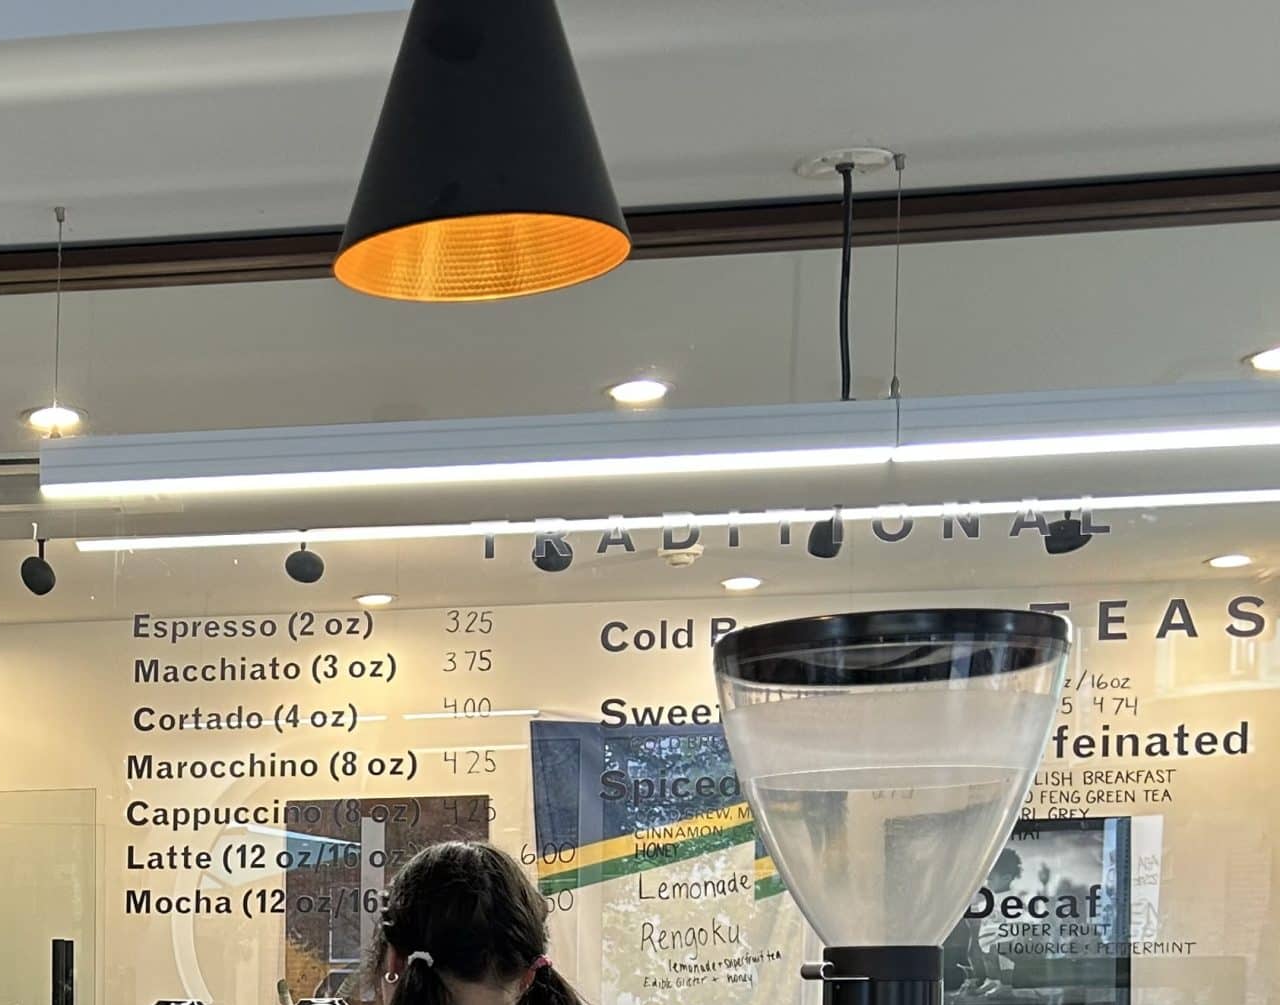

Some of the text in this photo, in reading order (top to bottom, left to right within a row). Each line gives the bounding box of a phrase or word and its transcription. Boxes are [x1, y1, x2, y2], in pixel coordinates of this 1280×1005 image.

[470, 500, 1112, 559] TRADITIONAL
[133, 610, 374, 643] Espresso (2 oz)
[600, 618, 694, 653] Cold
[133, 652, 397, 684] Macchiato (3 oz)
[133, 703, 358, 734] Cortado (4 oz)
[600, 698, 723, 729] Swee
[1052, 722, 1249, 758] feinated
[126, 749, 418, 781] Marocchino (8 oz)
[1083, 769, 1177, 785] BREAKFAST
[600, 770, 742, 806] Spiced
[1040, 790, 1082, 804] FENG
[1086, 789, 1137, 804] GREEN
[1143, 788, 1173, 803] TEA
[126, 797, 423, 830] Cappuccino (8 oz)
[1048, 807, 1090, 821] GREY
[126, 842, 361, 874] Latte (12 oz/16
[634, 841, 679, 859] HONEY
[638, 872, 752, 901] Lemonade
[963, 884, 1102, 920] Decaf
[126, 887, 380, 920] Mocha (12 oz/16
[640, 918, 741, 960] Rengoku
[997, 923, 1111, 938] SUPER FRUIT
[996, 941, 1198, 956] LIQUORICE PEPPERMINT
[668, 959, 716, 974] lemonade
[726, 973, 754, 988] honey
